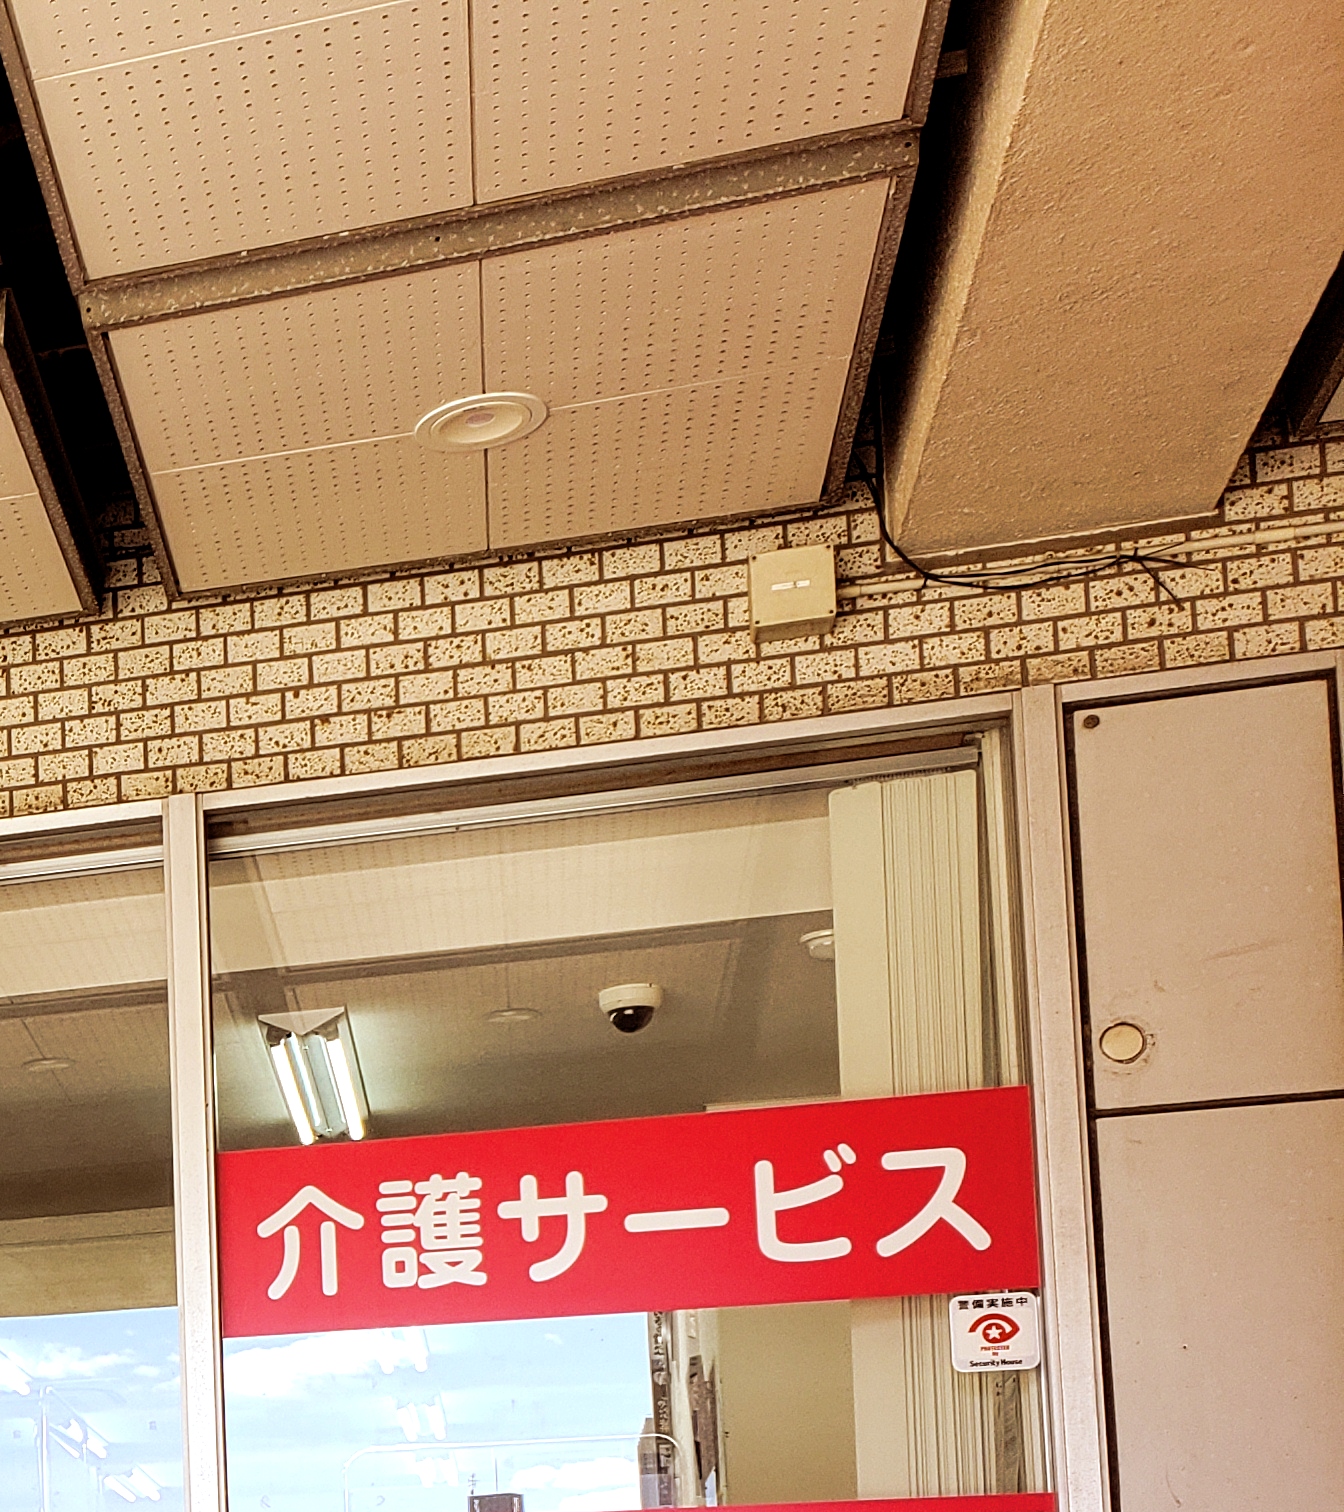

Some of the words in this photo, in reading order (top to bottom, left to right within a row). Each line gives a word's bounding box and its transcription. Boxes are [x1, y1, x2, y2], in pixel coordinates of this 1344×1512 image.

[257, 1143, 992, 1300] 介護サービス
[957, 1297, 1028, 1311] 警備実施中
[1000, 1358, 1023, 1366] House
